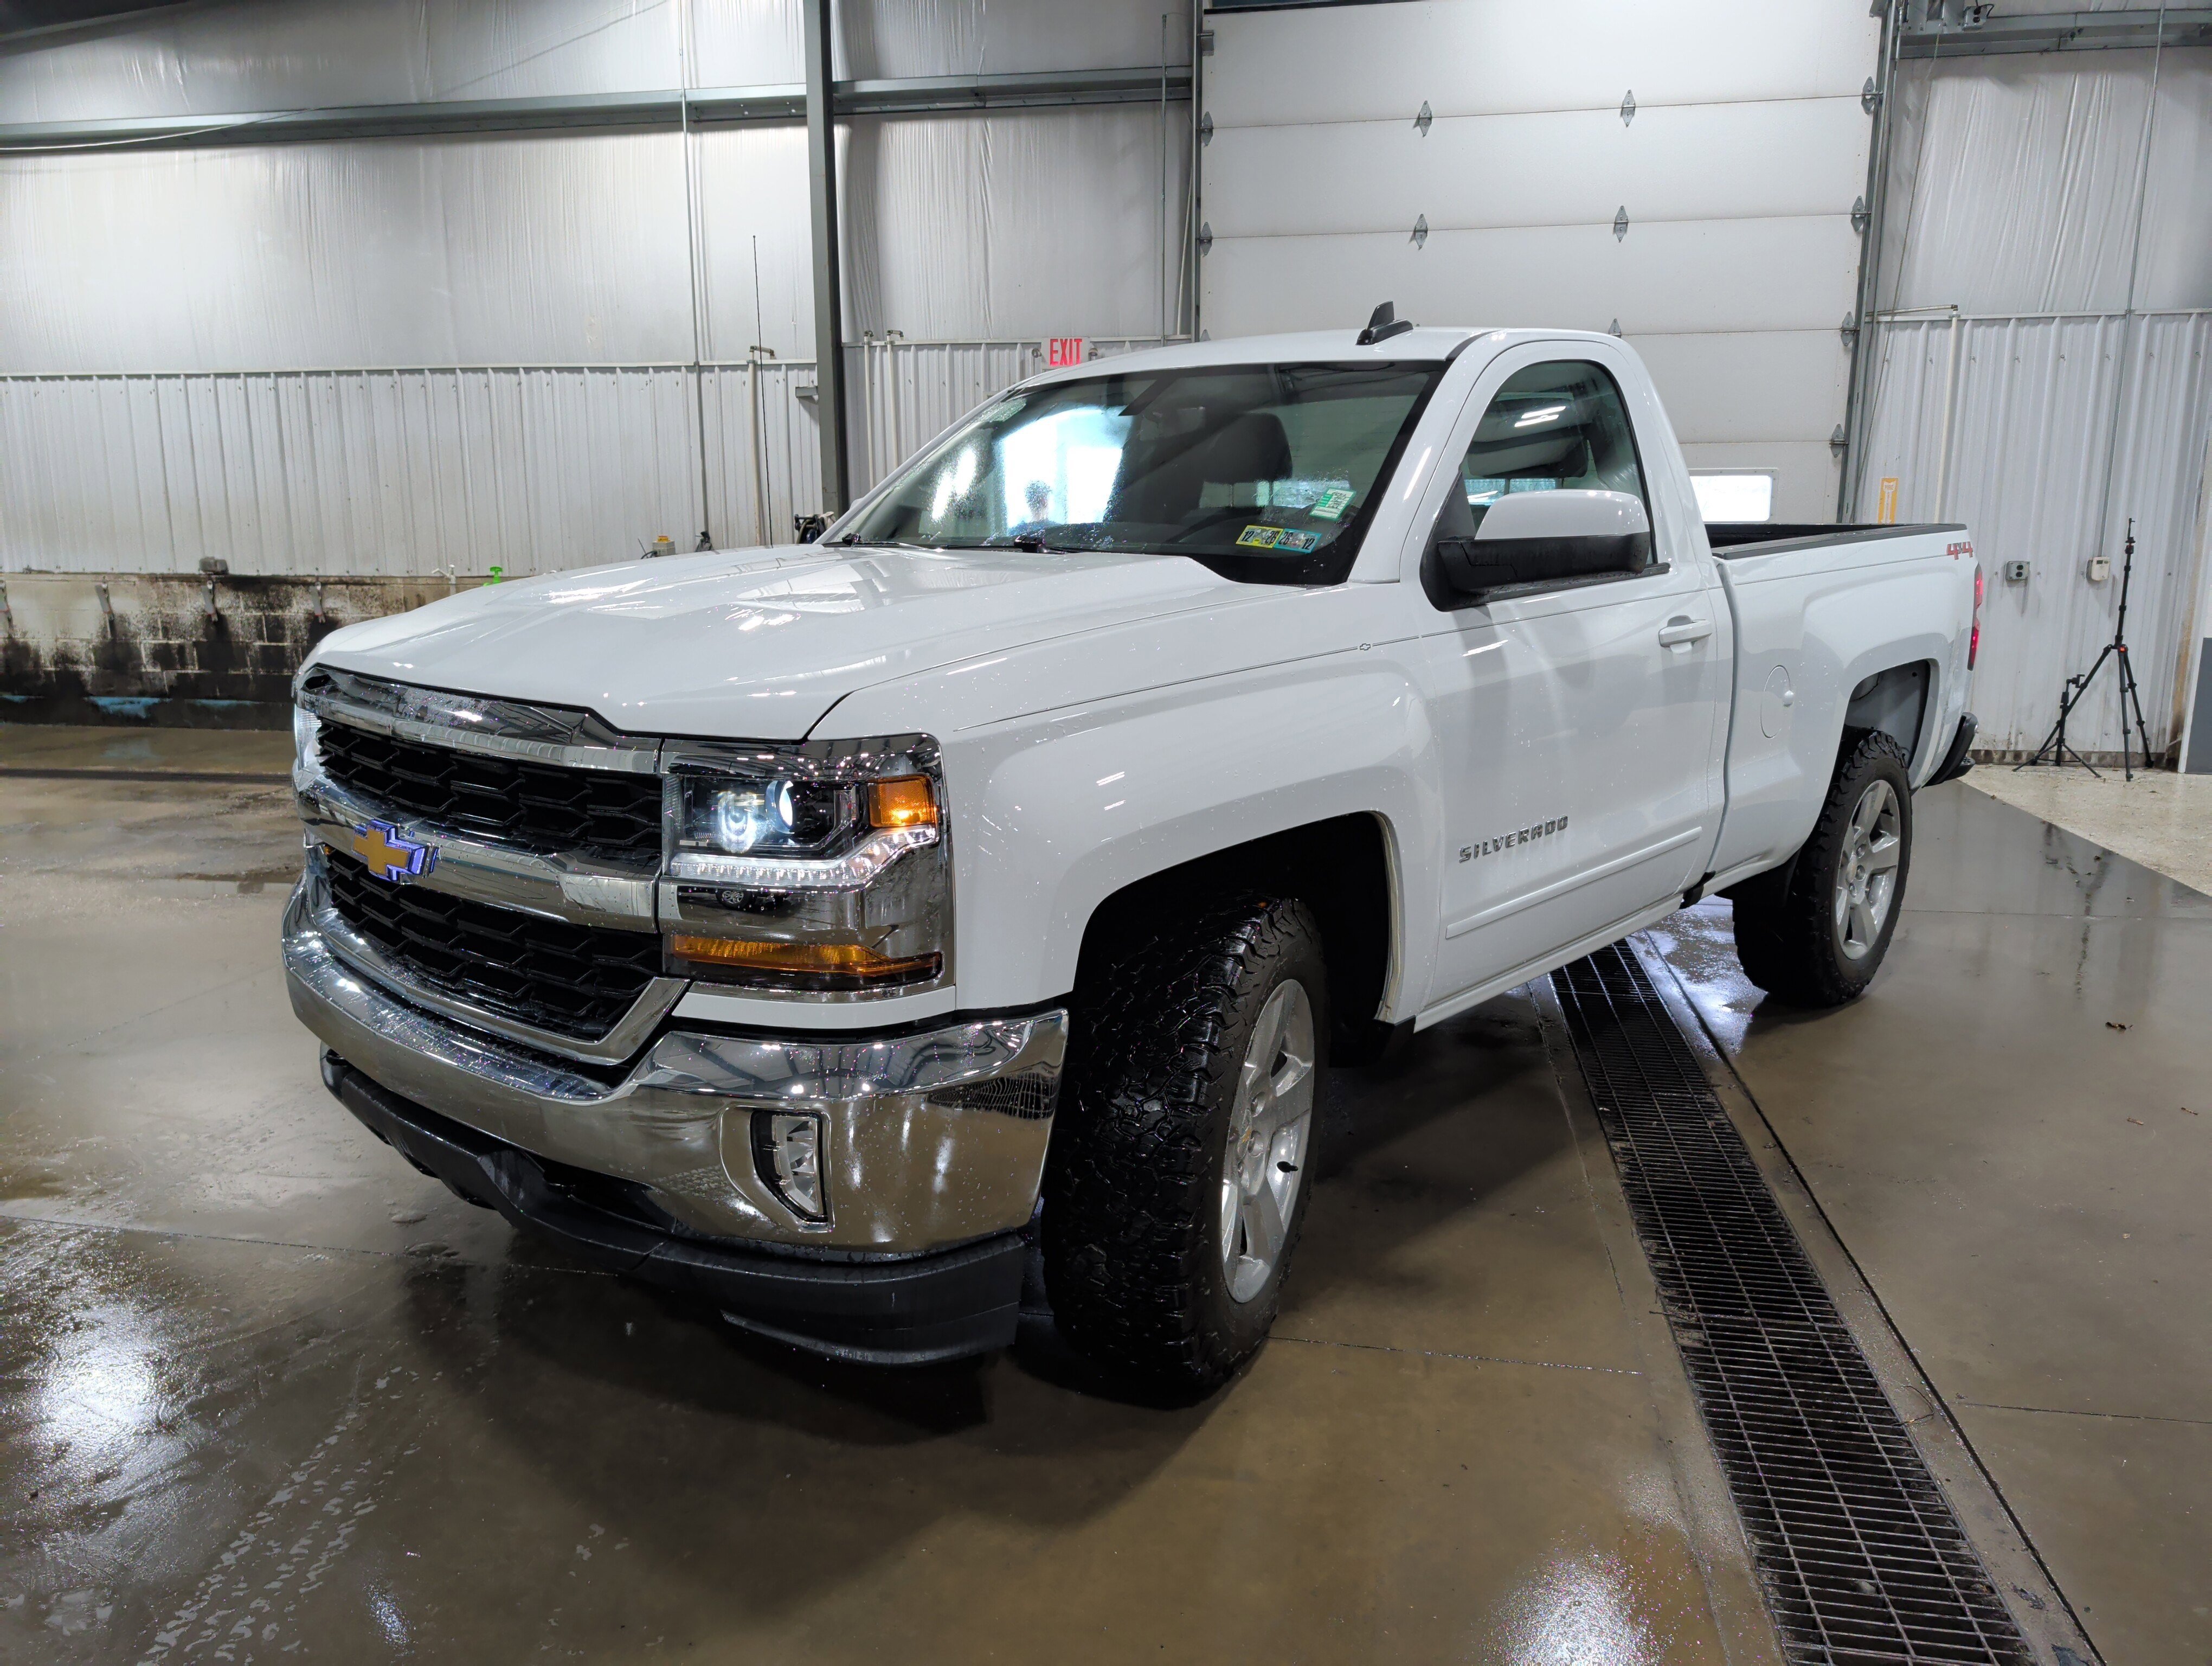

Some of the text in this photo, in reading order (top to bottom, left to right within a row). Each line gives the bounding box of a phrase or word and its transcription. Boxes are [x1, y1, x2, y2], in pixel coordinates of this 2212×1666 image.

[1050, 338, 1083, 366] EXIT
[1241, 530, 1255, 542] 12
[1278, 531, 1315, 550] 26 12
[1458, 815, 1568, 863] SILVERADO
